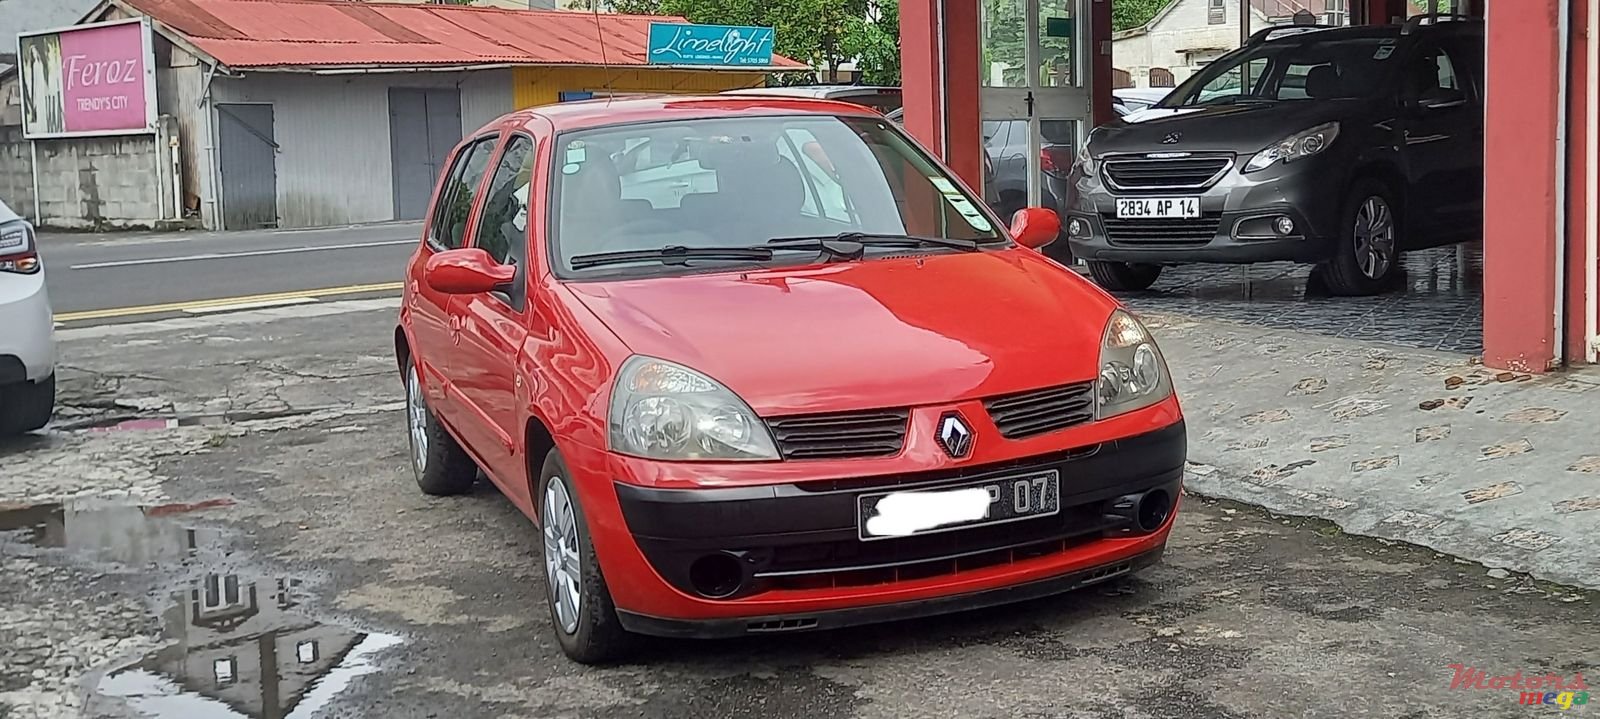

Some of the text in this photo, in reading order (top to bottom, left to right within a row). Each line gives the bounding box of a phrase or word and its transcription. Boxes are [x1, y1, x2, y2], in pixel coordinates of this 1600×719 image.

[652, 27, 772, 63] Limelight
[63, 55, 137, 91] Feroz
[76, 95, 129, 111] TRENDY'S CITY
[1120, 199, 1194, 216] 2834 AP 14
[1014, 477, 1048, 512] 07
